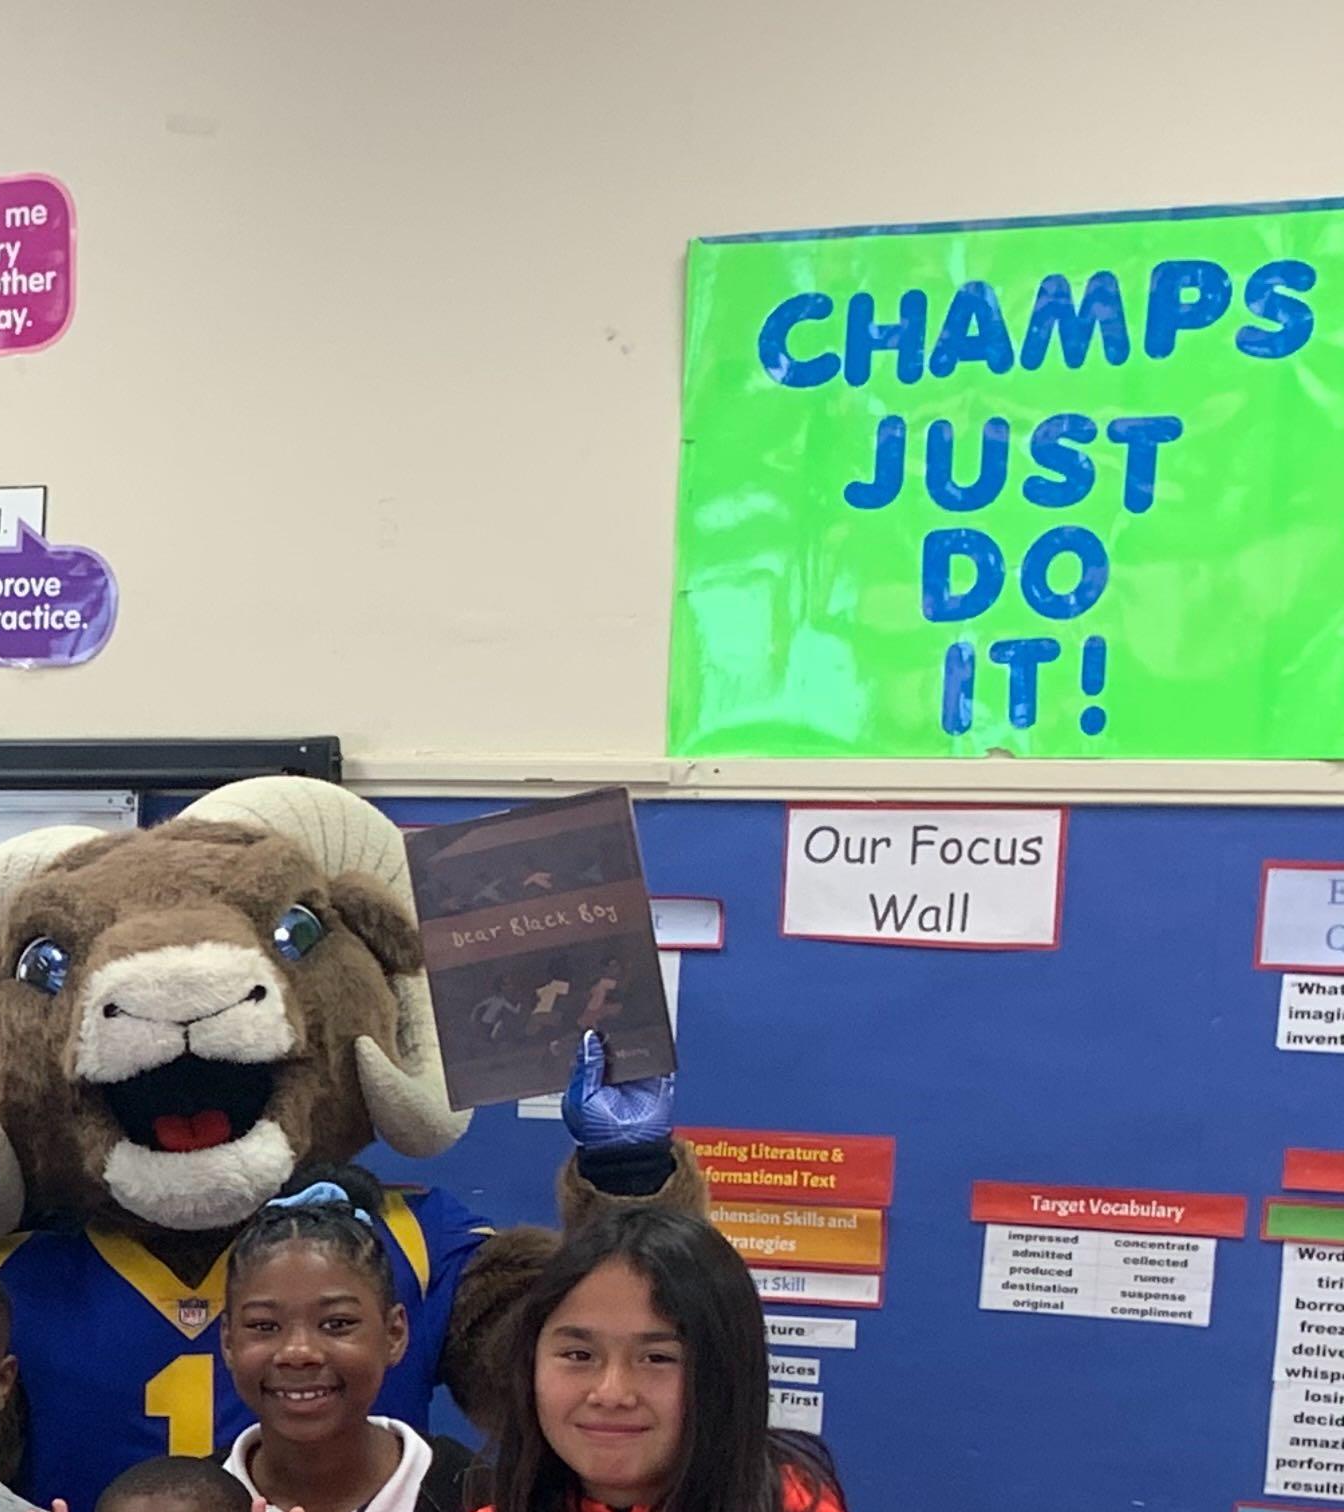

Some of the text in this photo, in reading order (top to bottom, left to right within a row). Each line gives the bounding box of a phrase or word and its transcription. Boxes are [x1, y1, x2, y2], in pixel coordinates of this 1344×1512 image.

[6, 204, 48, 228] me
[758, 260, 1317, 388] CHAMPS
[843, 414, 1183, 514] JUST
[922, 525, 1110, 623] DO
[941, 635, 1108, 736] IT!
[803, 825, 1043, 867] Our Focus
[868, 891, 970, 935] Wall
[452, 902, 618, 949] Dear Black Boy
[752, 1143, 830, 1162] Literature
[831, 1148, 844, 1163] &
[801, 1171, 836, 1188] Text
[1031, 1194, 1185, 1224] Target Vocabulary
[783, 1211, 857, 1229] Skills and
[1007, 1231, 1079, 1246] impressed
[1114, 1237, 1200, 1252] concentrate
[1012, 1249, 1072, 1261] admitted
[1122, 1255, 1188, 1268] collected
[1008, 1265, 1073, 1279] produced
[772, 1277, 805, 1292] Skill
[1001, 1280, 1078, 1295] destination
[1012, 1298, 1064, 1311] original
[1120, 1289, 1187, 1303] suspense
[1110, 1304, 1193, 1321] compliment
[144, 1353, 214, 1459] 1
[781, 1392, 819, 1407] First
